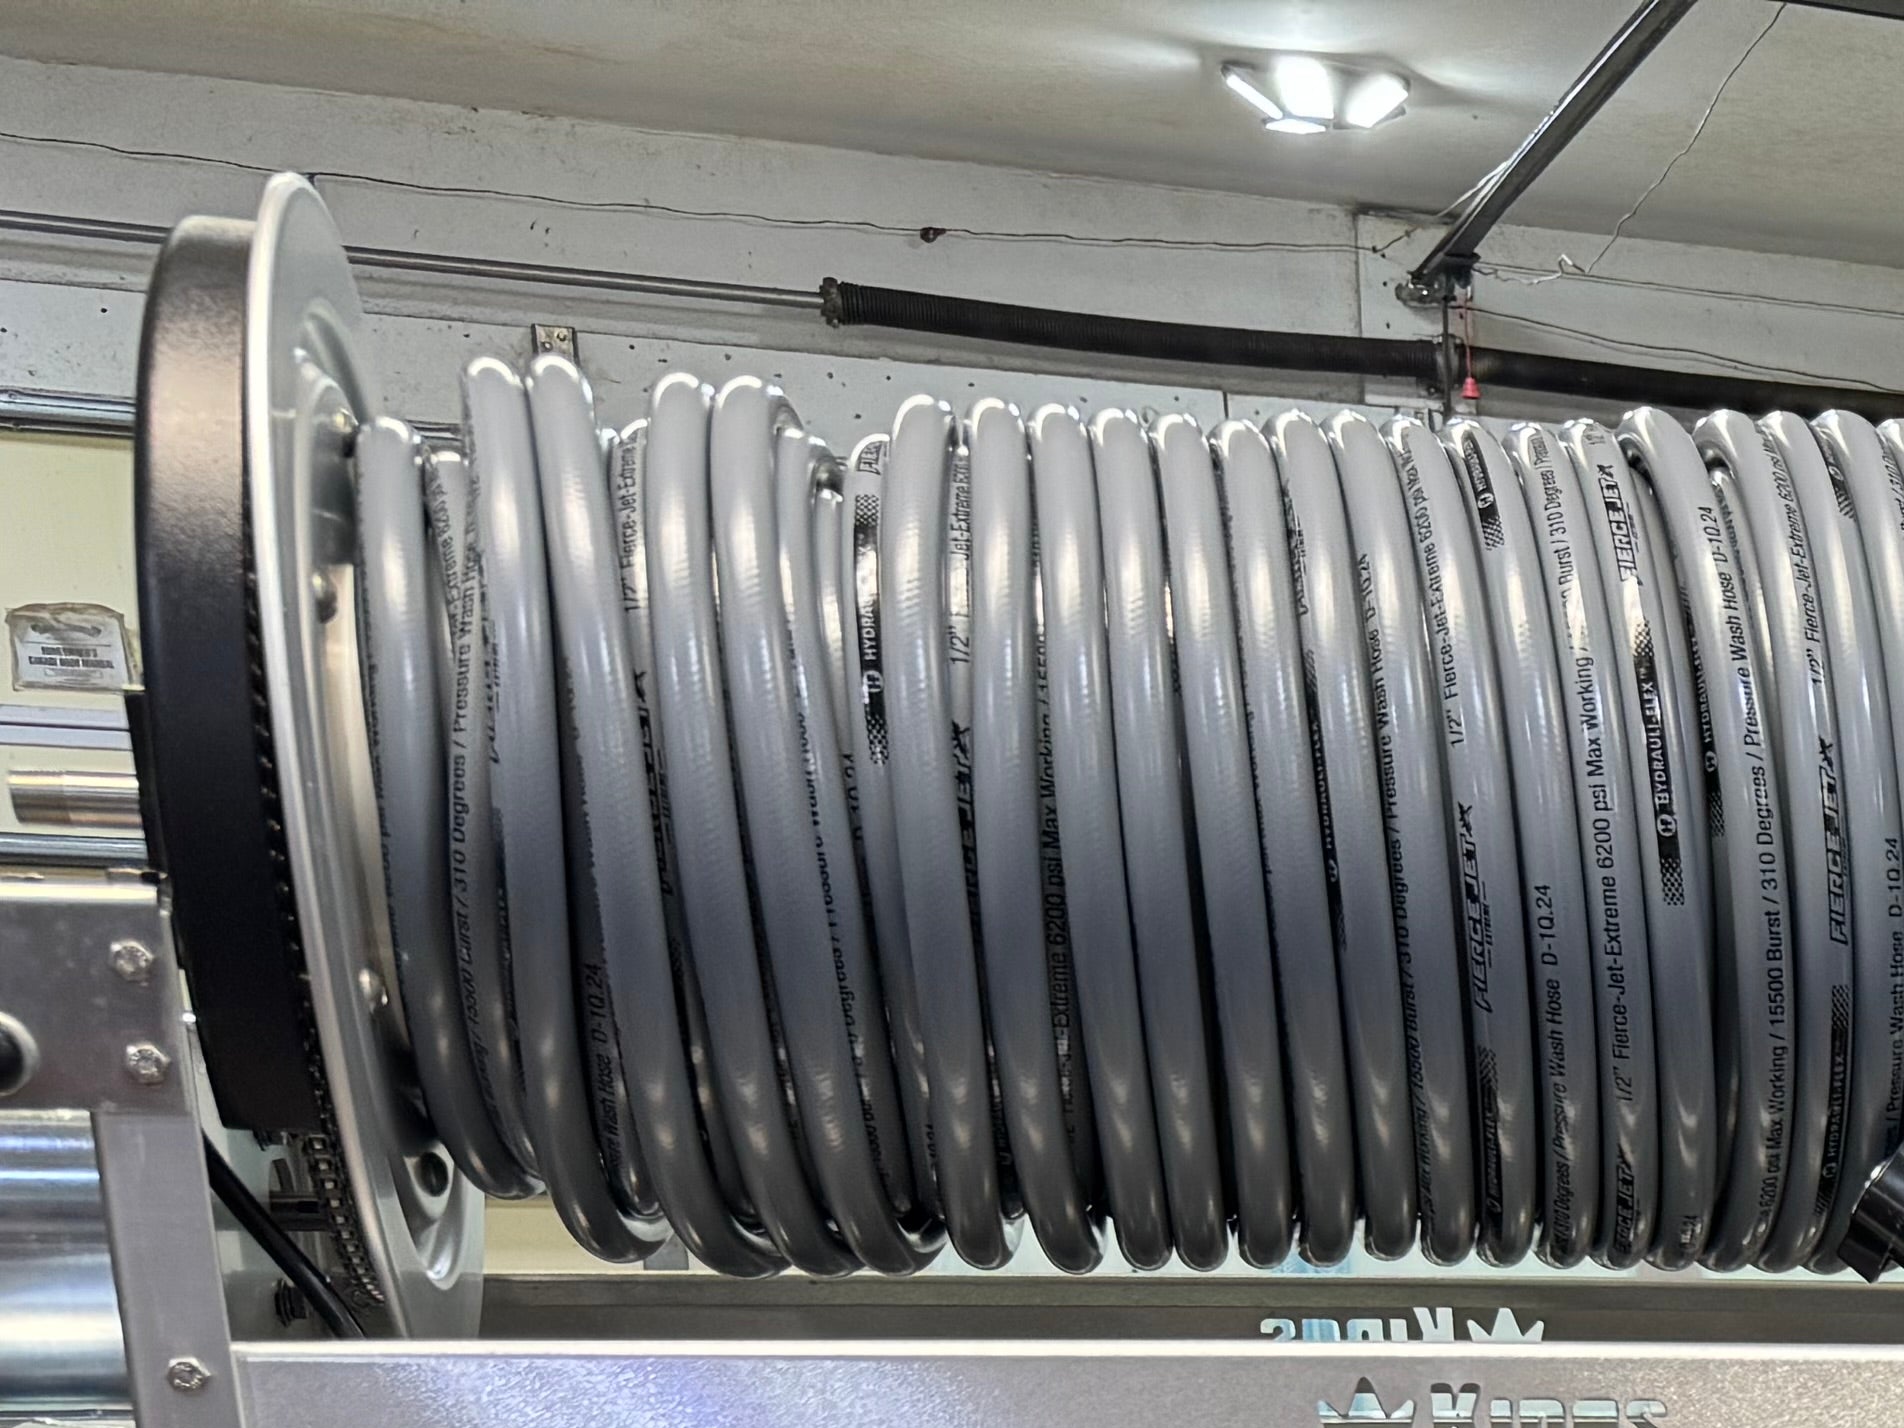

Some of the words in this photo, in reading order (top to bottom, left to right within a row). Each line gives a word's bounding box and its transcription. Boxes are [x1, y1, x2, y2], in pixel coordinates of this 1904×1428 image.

[1548, 511, 1567, 536] 310
[1718, 572, 1737, 611] Hose
[1782, 504, 1820, 643] Fierce-Jet-Extreme
[1422, 542, 1460, 700] Fierce-Jet-Extreme
[1721, 616, 1748, 661] Wash
[1360, 628, 1384, 674] Hose
[451, 642, 473, 733] Pressure
[1368, 678, 1393, 729] Wash
[1572, 656, 1601, 731] Working
[1734, 668, 1763, 747] Pressure
[1378, 734, 1399, 820] Pressure
[1583, 737, 1606, 777] Max
[450, 757, 469, 844] Degrees
[1588, 783, 1614, 812] psi
[1750, 766, 1776, 850] Degrees
[1040, 805, 1061, 849] Max
[1592, 818, 1614, 870] 6200
[1044, 856, 1066, 888] psi
[1759, 853, 1778, 891] 310
[1043, 893, 1066, 946] 6200
[1763, 910, 1782, 961] Burst
[1599, 875, 1632, 1061] Fierce-Jet-Extreme
[1887, 931, 1904, 977] Hose
[1543, 978, 1563, 1025] Hose
[1767, 967, 1785, 1027] 15500
[1886, 983, 1904, 1035] Wash
[1547, 1030, 1567, 1077] Wash
[1883, 1039, 1904, 1112] Pressure
[1769, 1046, 1788, 1115] Working
[1767, 1120, 1783, 1149] Max
